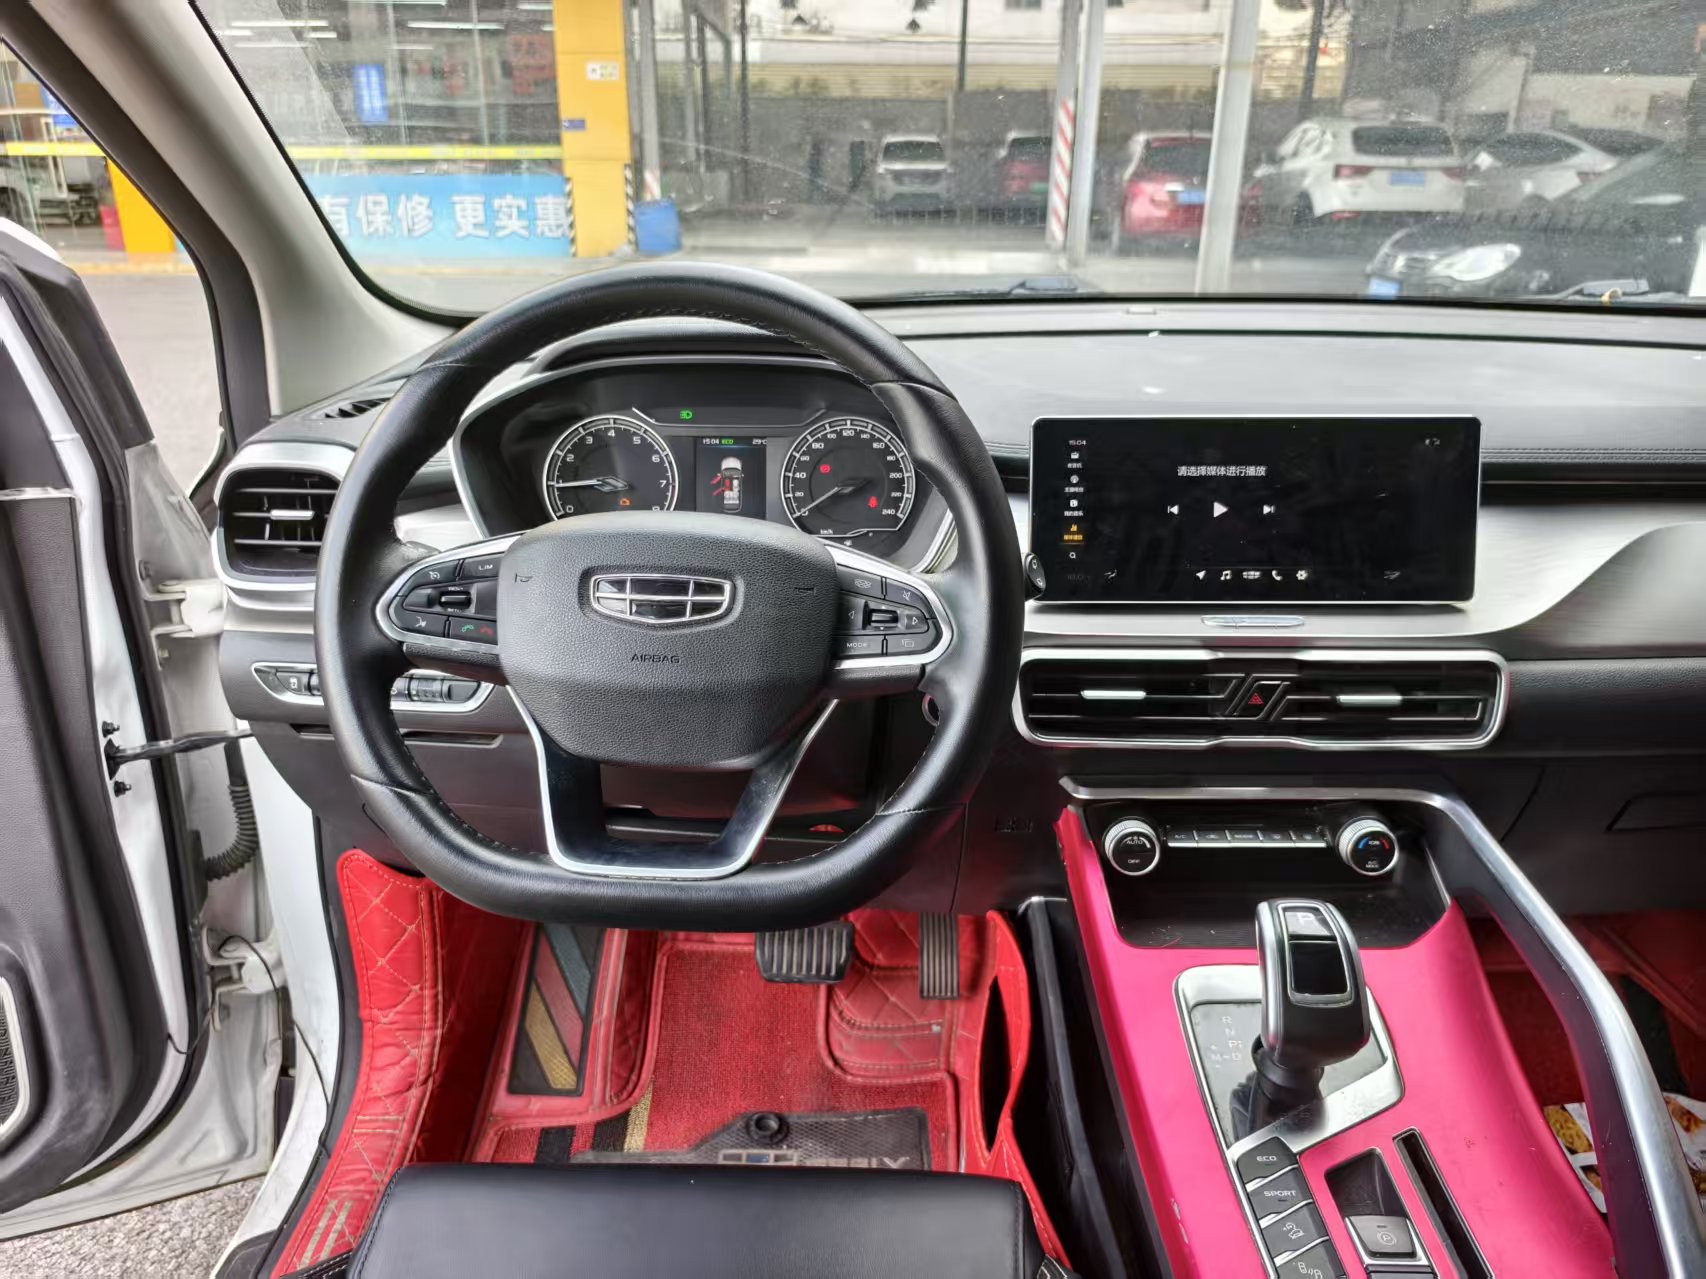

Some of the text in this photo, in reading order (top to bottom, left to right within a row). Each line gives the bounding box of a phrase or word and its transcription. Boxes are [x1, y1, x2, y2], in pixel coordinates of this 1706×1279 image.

[319, 193, 571, 239] 有保修 更实惠
[607, 429, 616, 438] 4
[566, 454, 574, 462] 2
[652, 454, 661, 463] 6
[1177, 465, 1268, 477] 请选择媒体进行播放
[659, 480, 667, 488] 7
[566, 505, 574, 514] 0
[631, 653, 680, 664] AIRBAG
[1296, 912, 1316, 927] P
